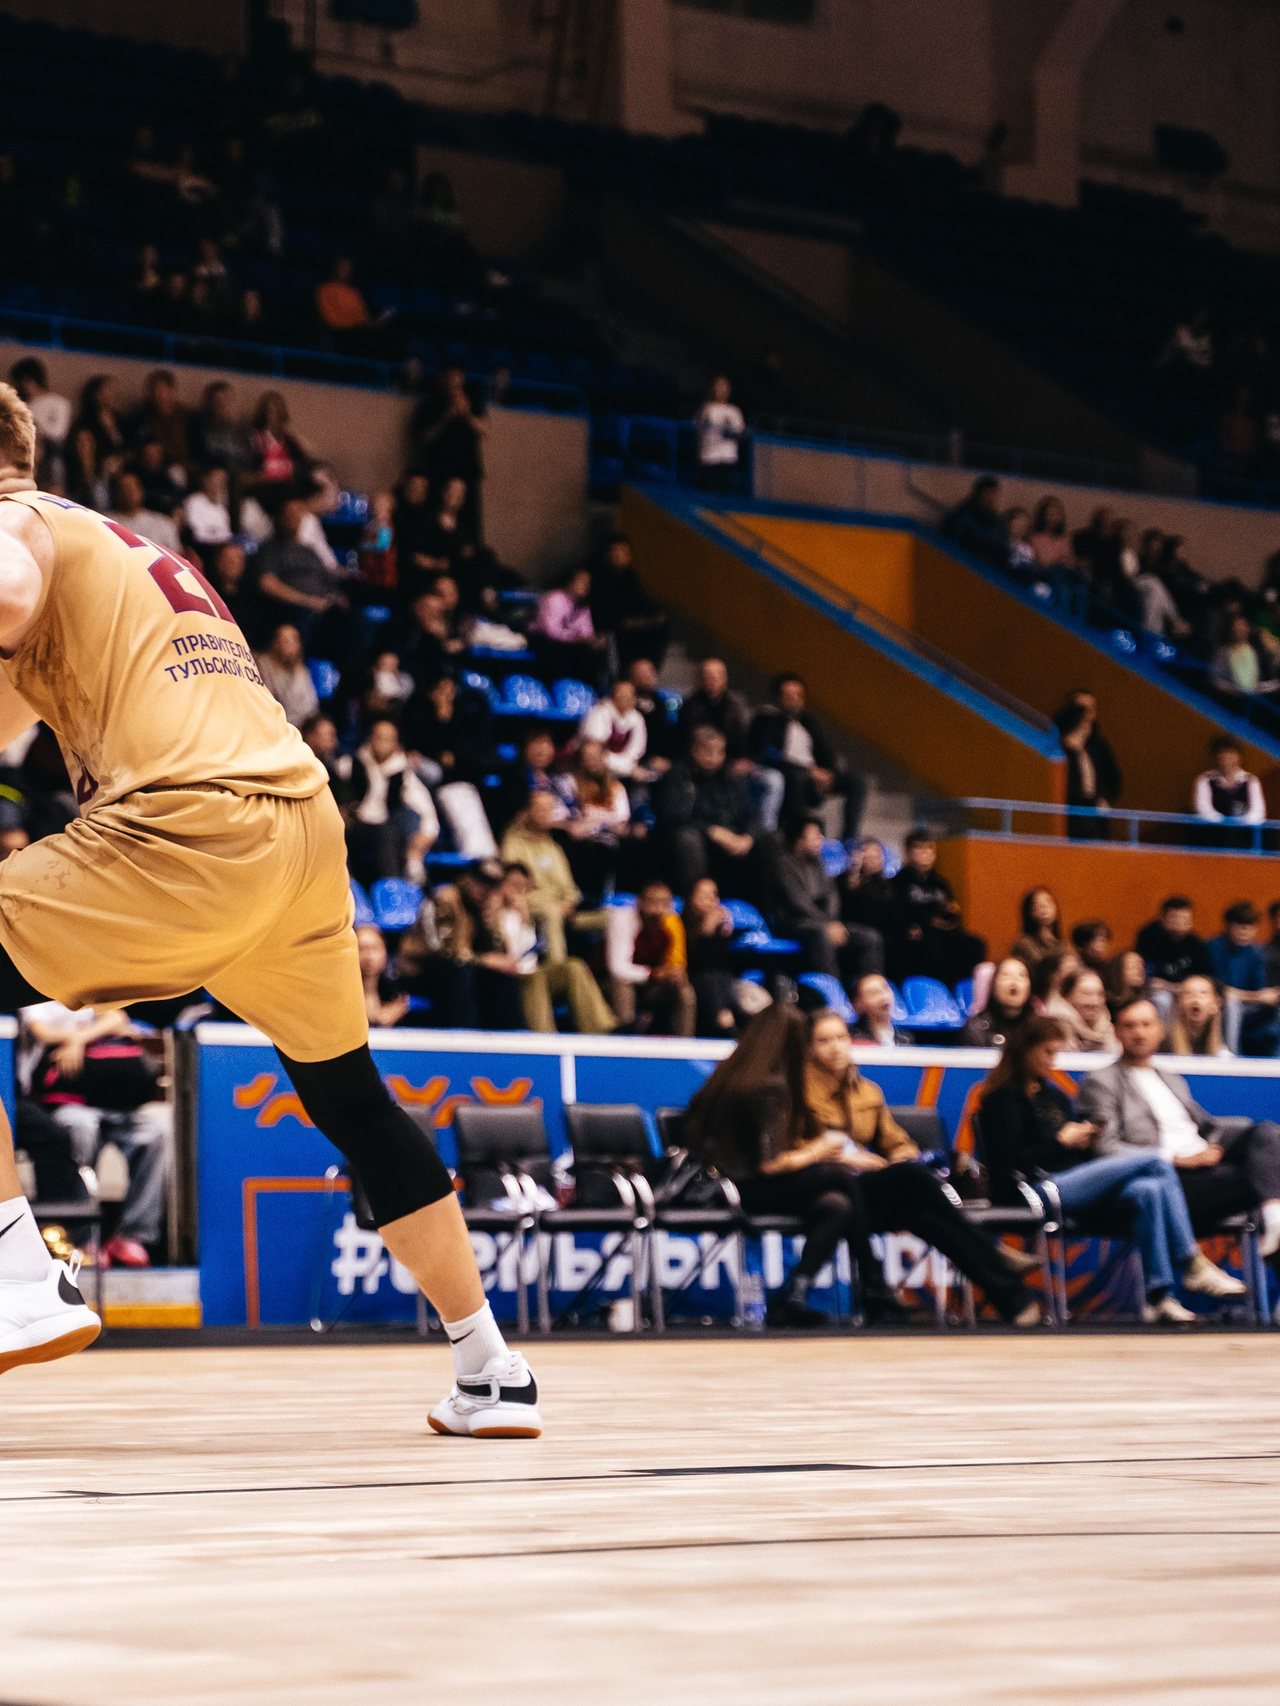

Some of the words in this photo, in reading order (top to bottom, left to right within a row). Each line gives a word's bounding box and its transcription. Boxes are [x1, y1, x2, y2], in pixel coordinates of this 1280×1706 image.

[102, 521, 238, 626] 2
[172, 633, 257, 668] ПРАВИТЕЛЬ
[164, 656, 245, 683] ТУЛЬСКОЙ
